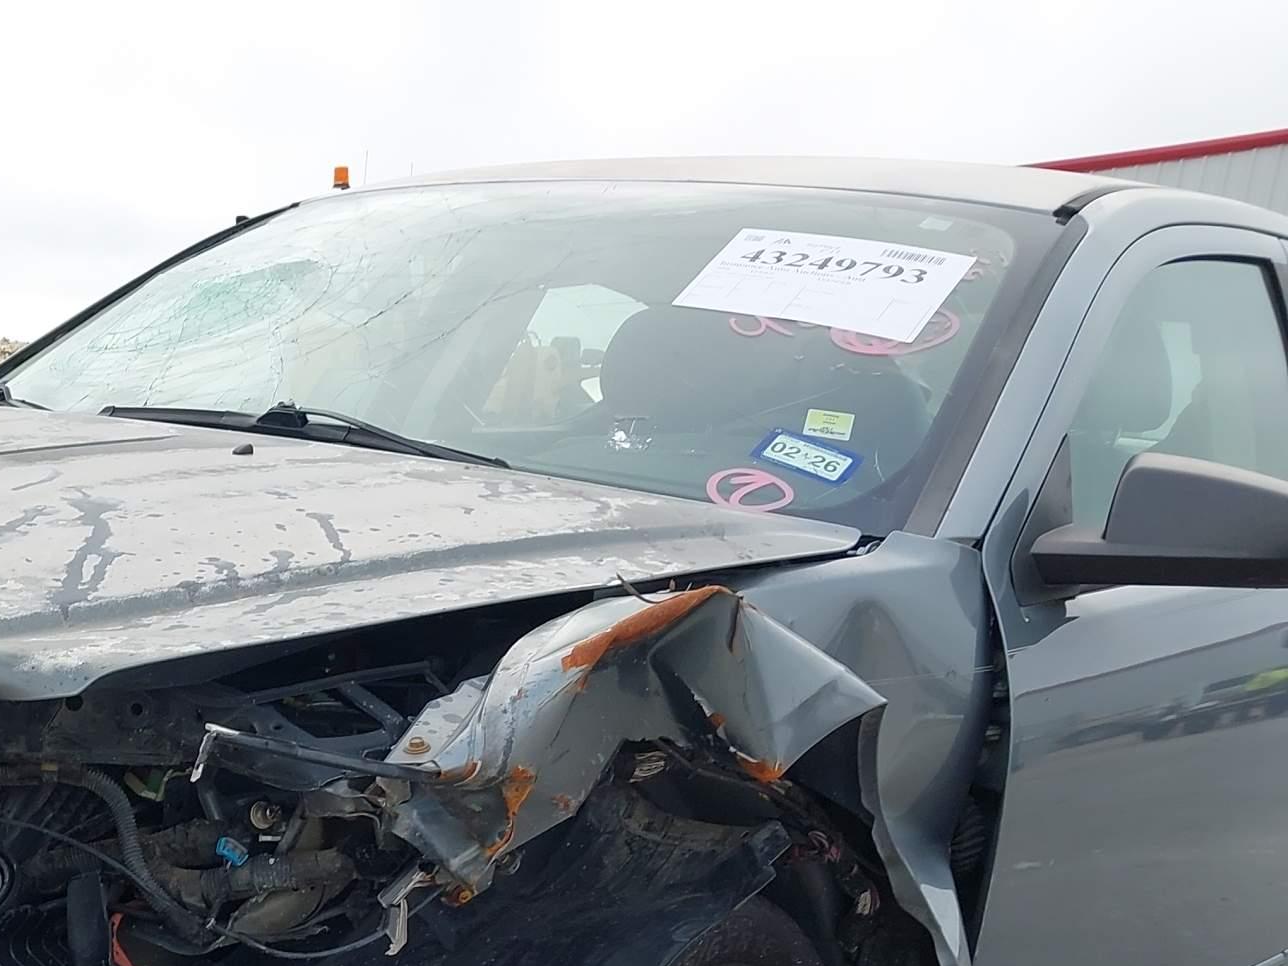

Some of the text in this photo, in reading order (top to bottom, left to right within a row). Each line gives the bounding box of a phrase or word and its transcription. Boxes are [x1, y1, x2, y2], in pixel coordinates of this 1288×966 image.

[741, 248, 928, 285] 43249793
[770, 441, 801, 459] 02
[808, 455, 841, 473] 26
